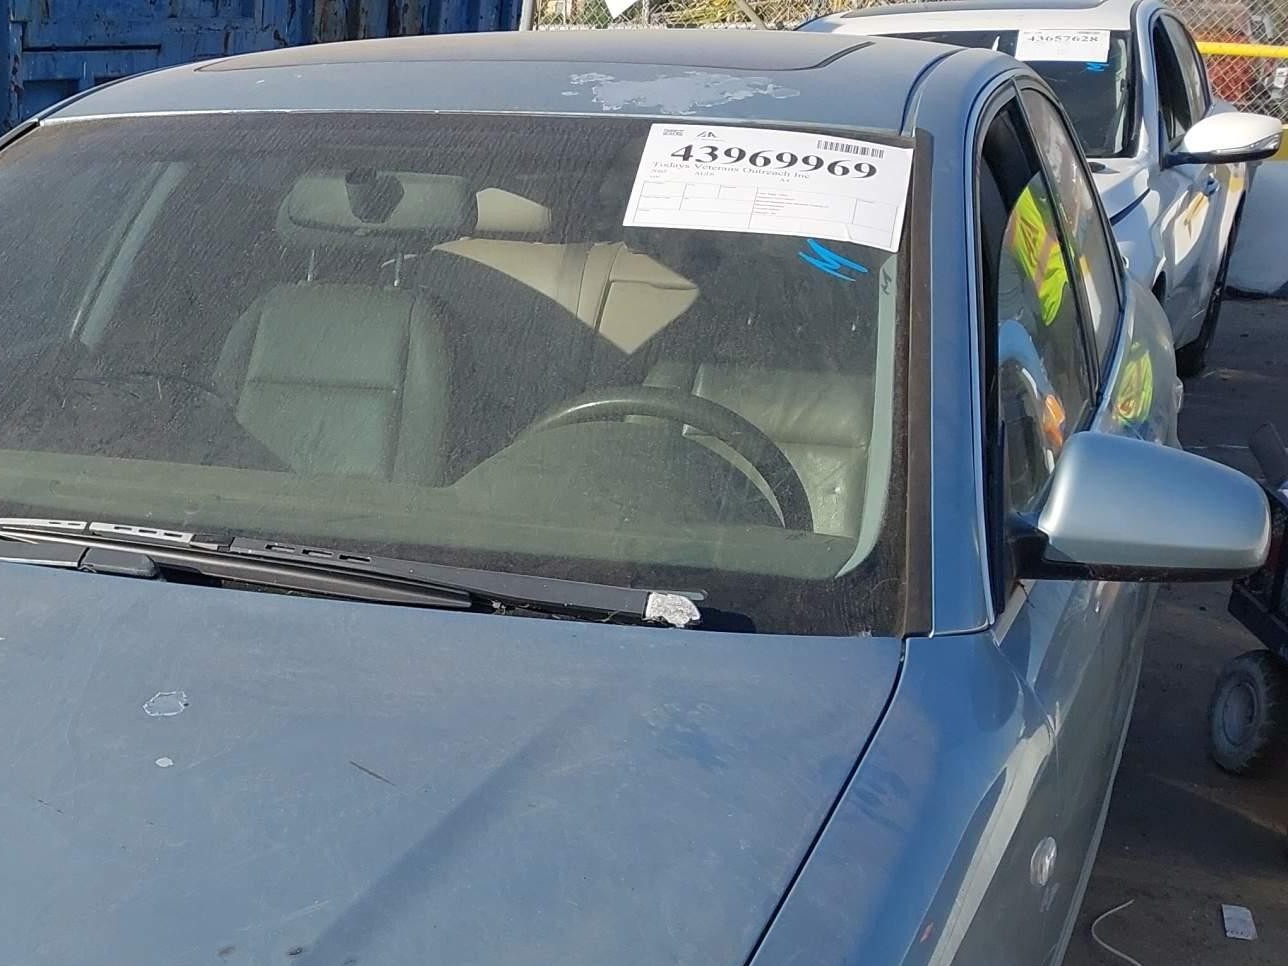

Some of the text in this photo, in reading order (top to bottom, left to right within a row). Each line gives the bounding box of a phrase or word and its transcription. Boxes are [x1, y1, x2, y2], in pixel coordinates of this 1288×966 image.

[652, 161, 690, 169] Todays
[694, 163, 740, 173] Veterans
[742, 167, 790, 177] Outreach
[670, 143, 877, 179] 43969969
